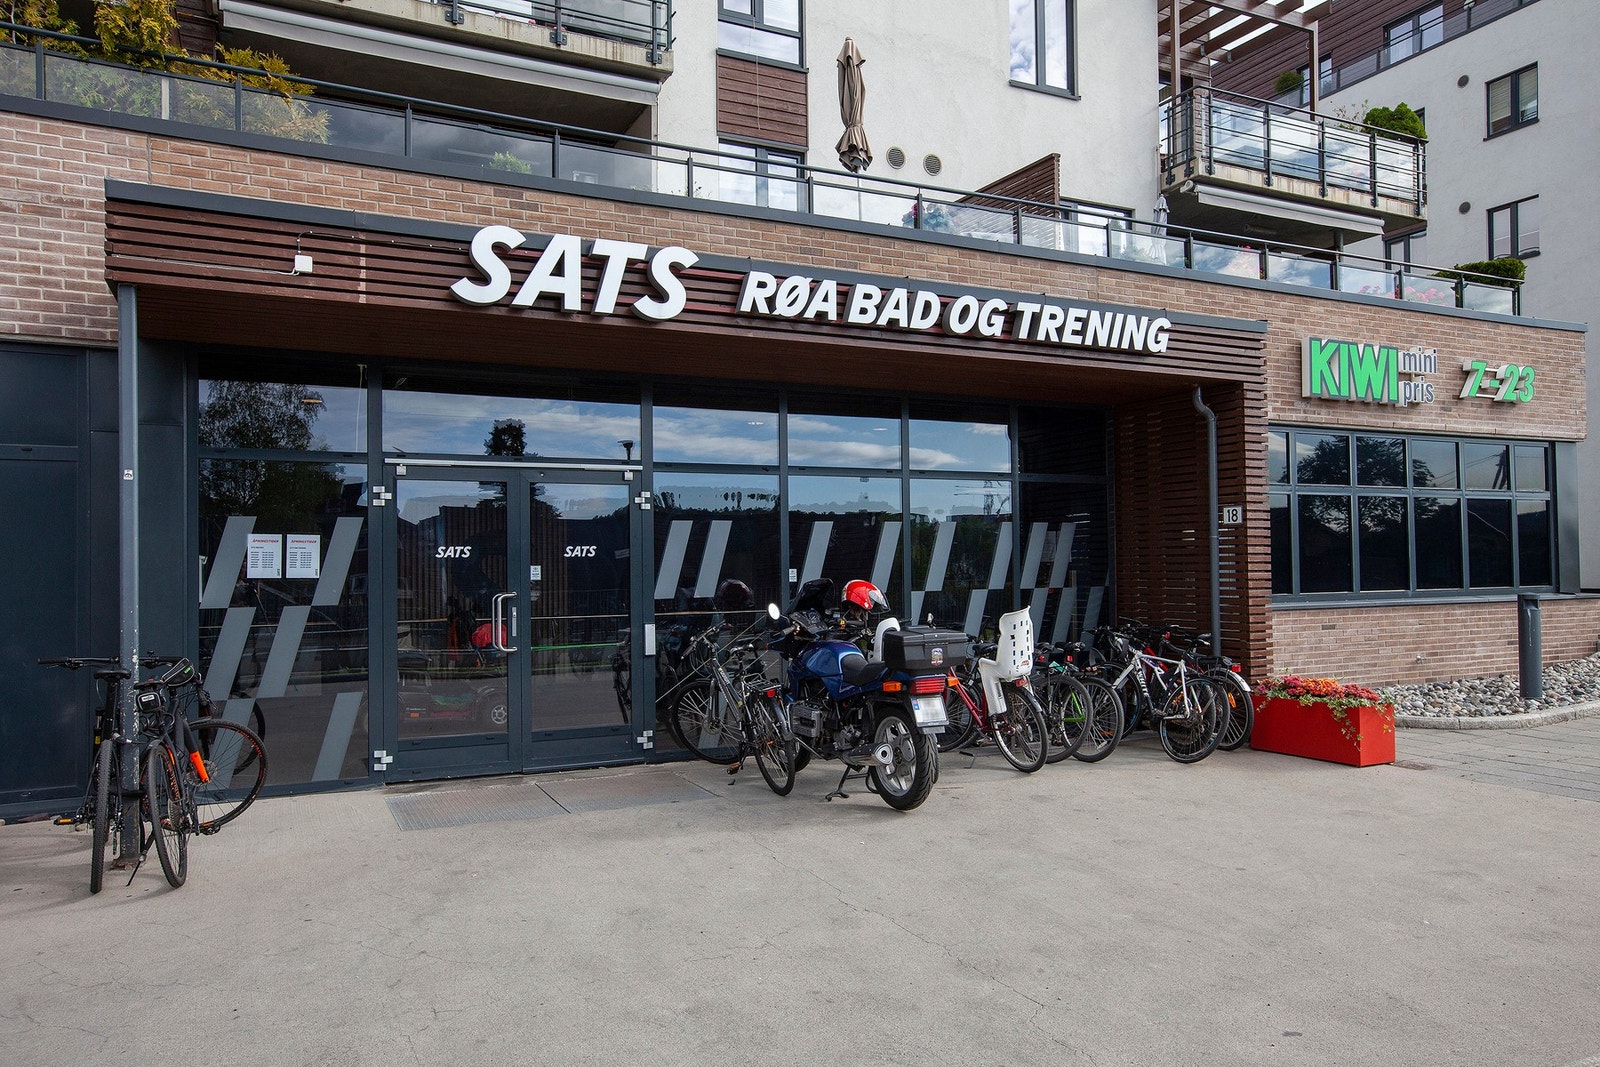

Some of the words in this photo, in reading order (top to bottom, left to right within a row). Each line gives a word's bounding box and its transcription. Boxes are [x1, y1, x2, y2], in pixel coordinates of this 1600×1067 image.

[450, 225, 700, 321] SATS
[739, 271, 838, 321] RØA
[847, 283, 941, 330] BAD
[948, 295, 1008, 337] OG
[1014, 302, 1172, 353] TRENING
[1308, 337, 1399, 404] KIWI
[1402, 346, 1437, 374] mini
[1402, 376, 1435, 408] pris
[1227, 508, 1239, 522] 18
[435, 546, 472, 558] SATS
[564, 545, 597, 557] SATS
